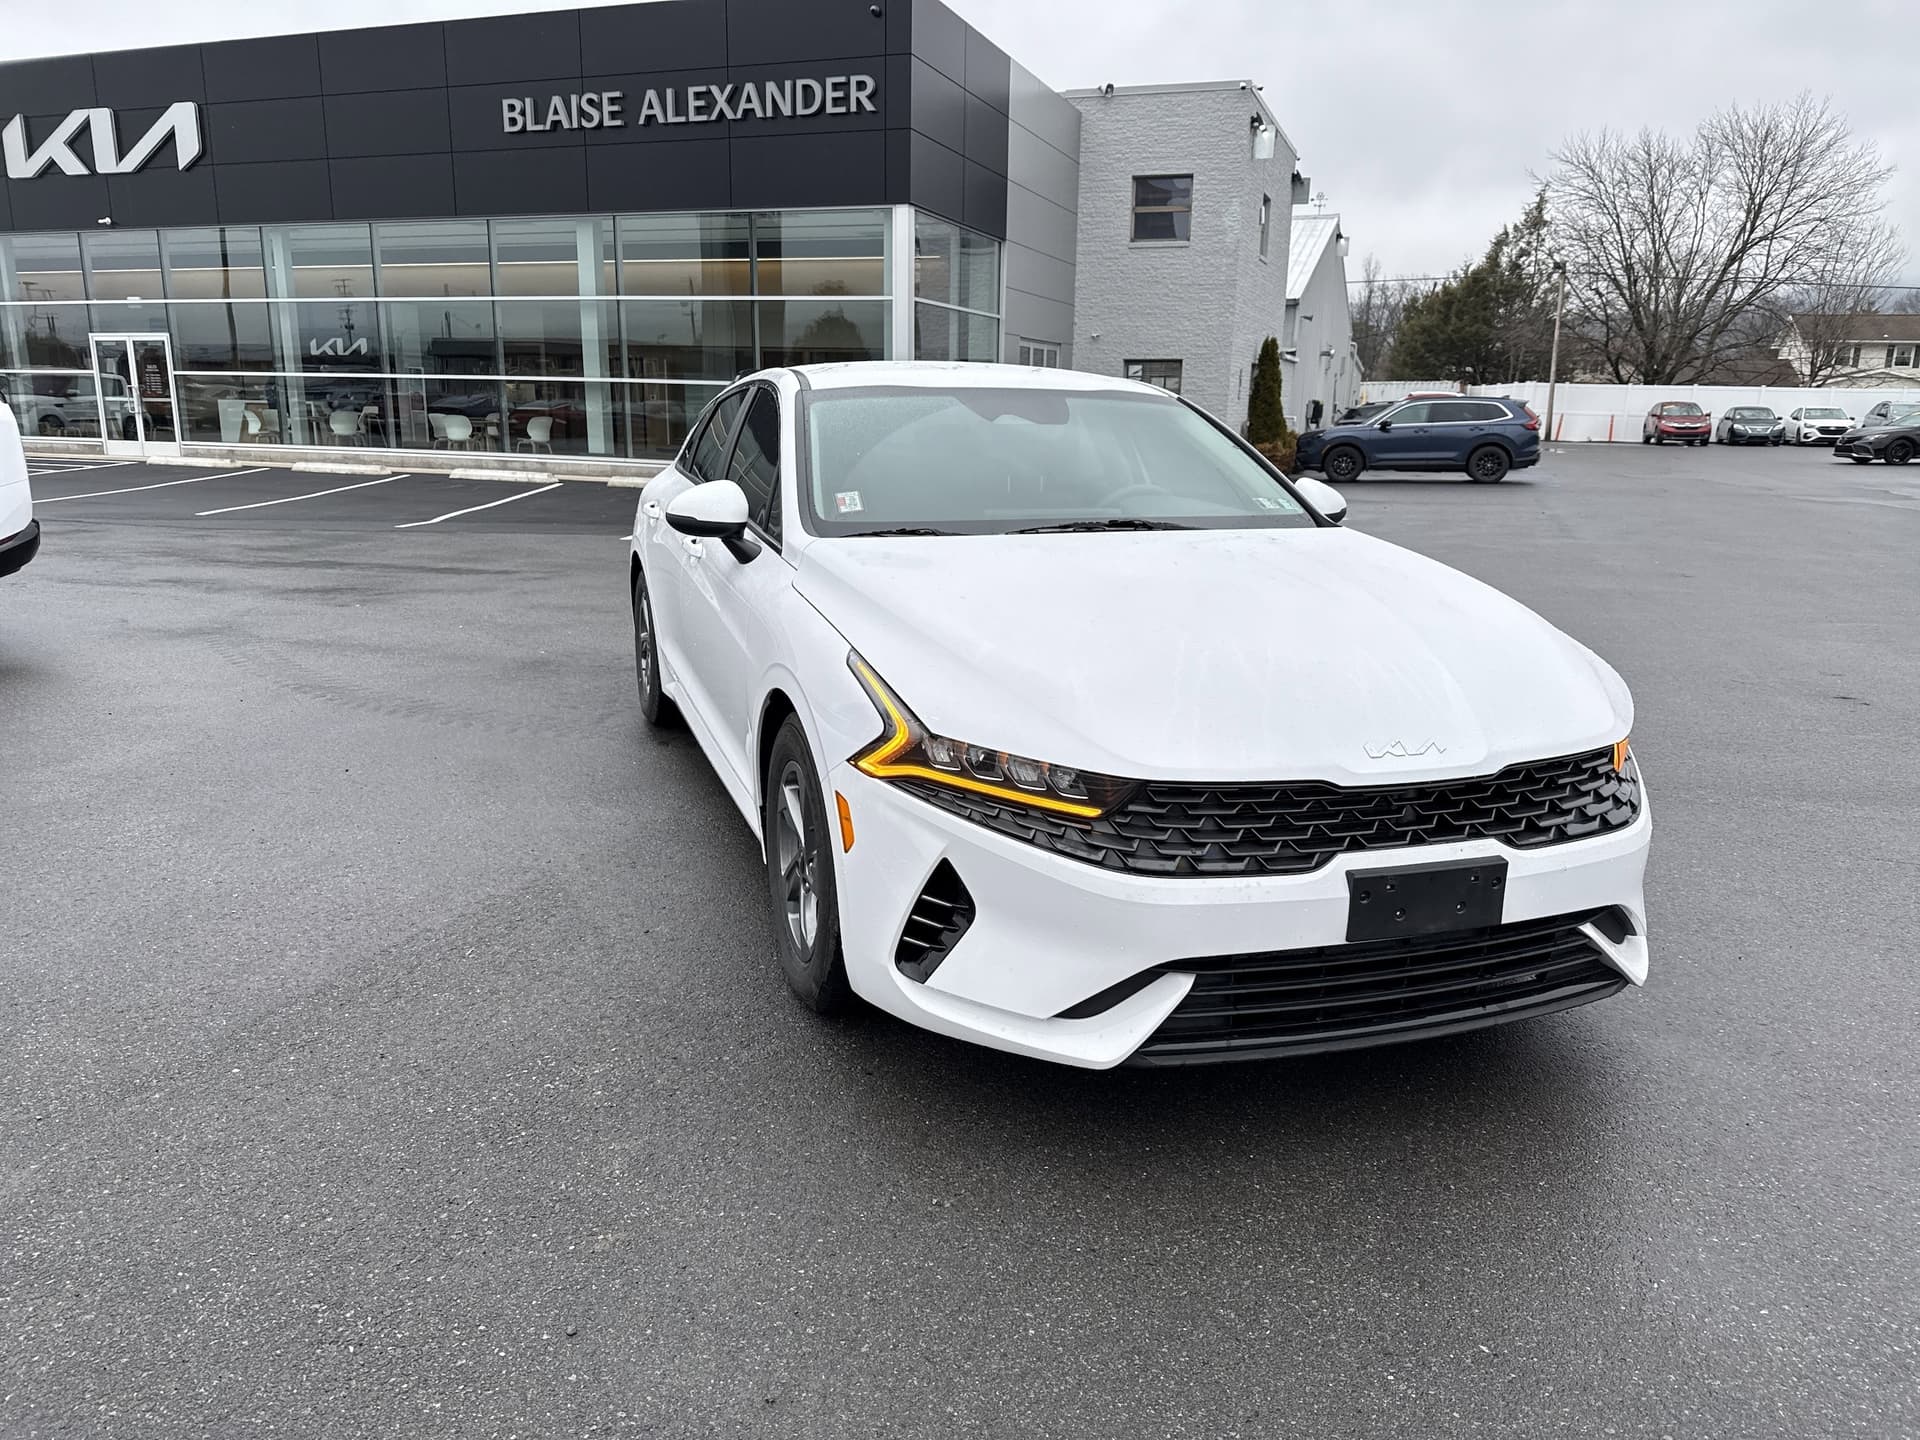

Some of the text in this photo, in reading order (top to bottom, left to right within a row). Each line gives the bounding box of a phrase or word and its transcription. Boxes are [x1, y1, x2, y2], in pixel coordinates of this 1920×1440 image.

[502, 74, 877, 133] BLAISE ALEXANDER
[2, 101, 202, 179] KIA
[310, 337, 368, 356] KIA
[1362, 737, 1447, 759] KIA
